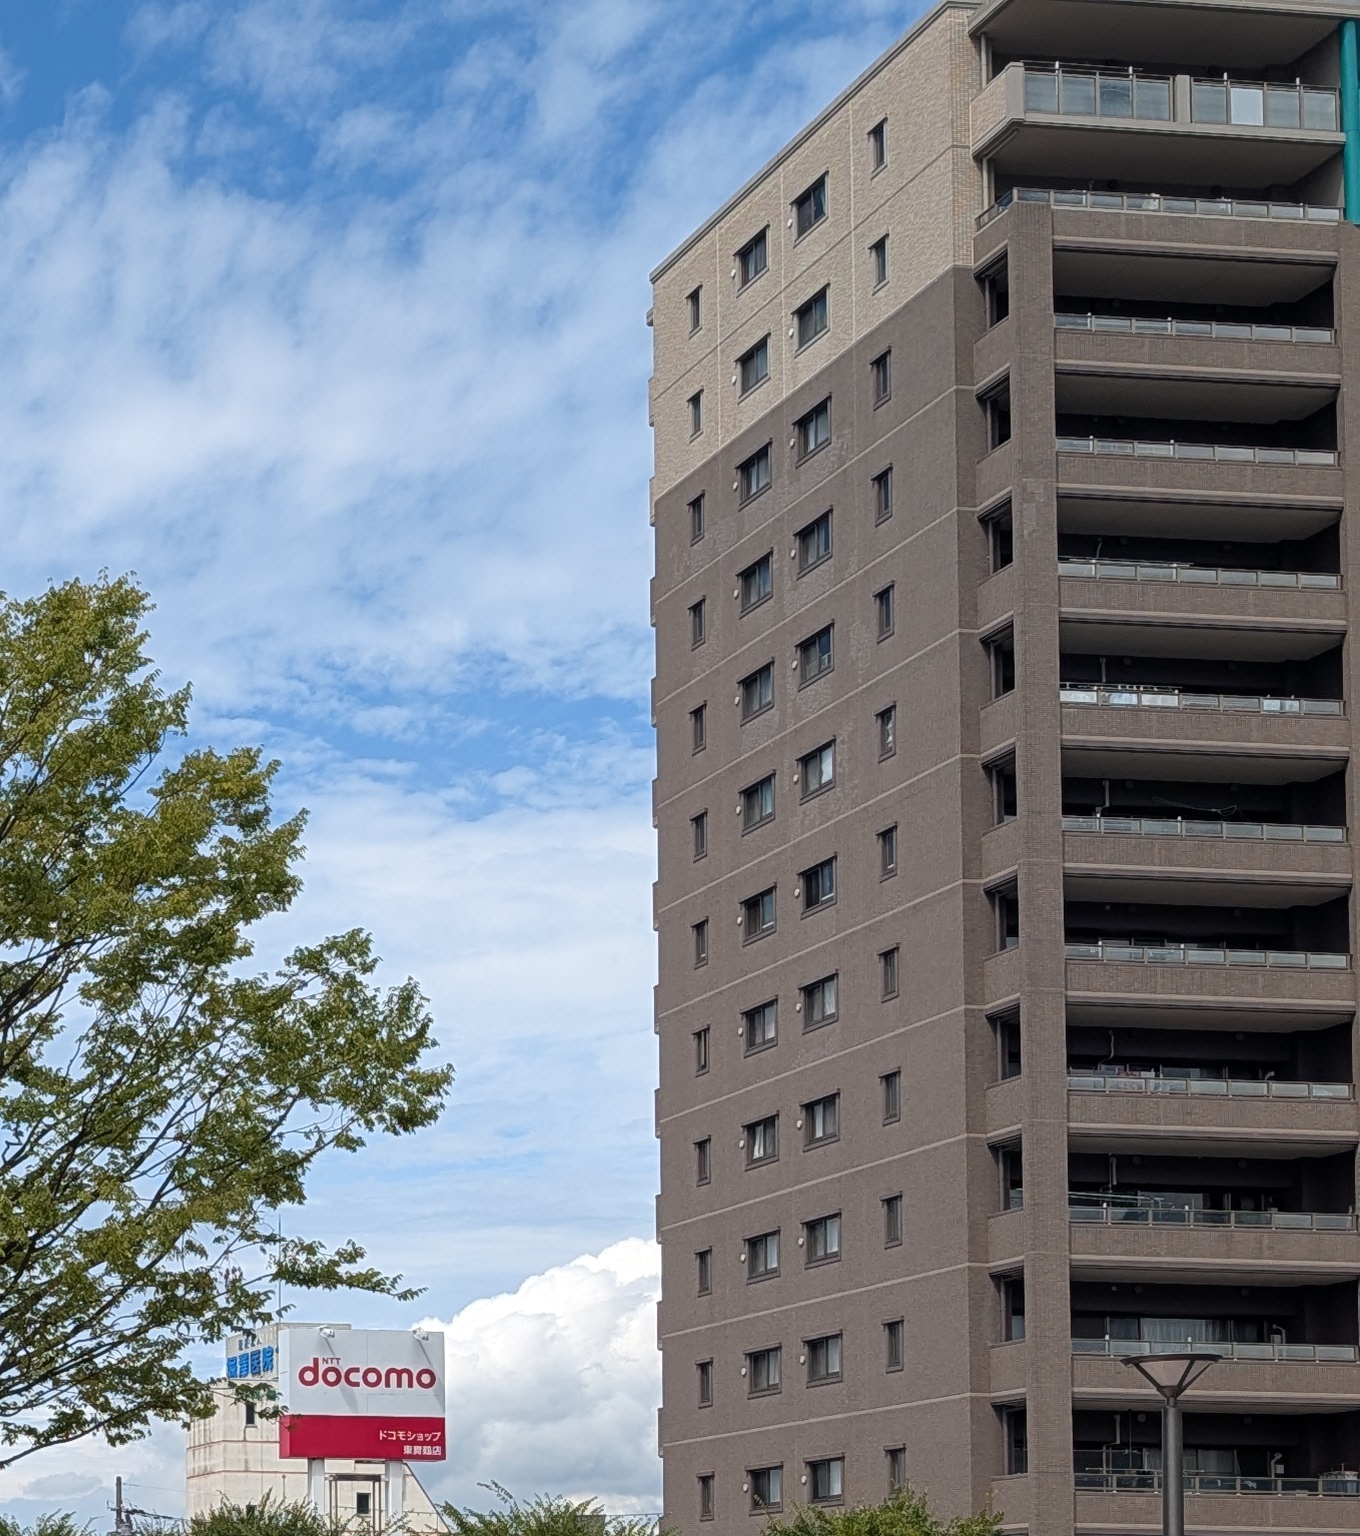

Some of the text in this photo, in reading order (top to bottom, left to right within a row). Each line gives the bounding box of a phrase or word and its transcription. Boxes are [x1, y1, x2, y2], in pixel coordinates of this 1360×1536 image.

[322, 1357, 341, 1365] NTT
[298, 1357, 437, 1389] docomo
[379, 1430, 442, 1442] ドコモショップ
